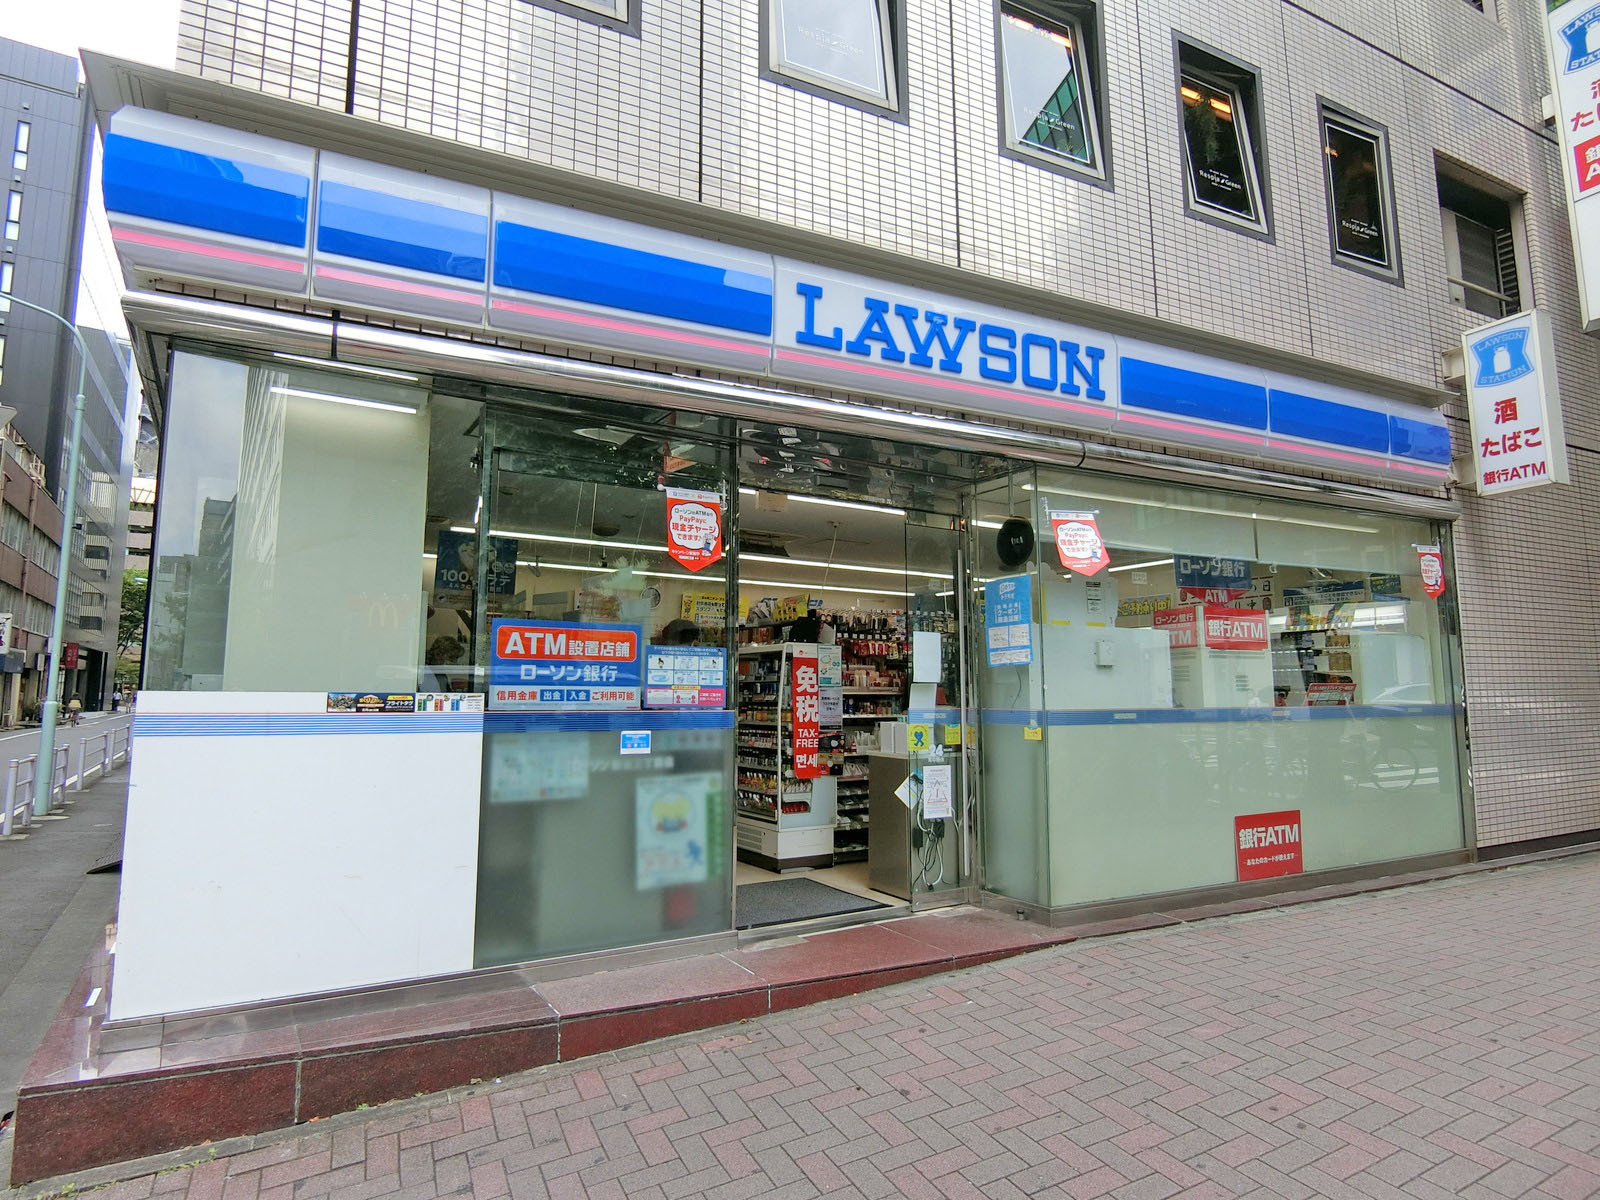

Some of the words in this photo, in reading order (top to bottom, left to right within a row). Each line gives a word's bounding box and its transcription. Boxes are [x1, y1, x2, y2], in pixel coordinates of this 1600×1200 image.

[796, 282, 1106, 400] LAWSON
[1477, 331, 1524, 351] LAWSON
[1480, 364, 1527, 384] STATION
[1494, 397, 1518, 425] 酒
[1481, 426, 1542, 457] たばこ
[1483, 461, 1546, 486] 銀行ATM
[672, 522, 717, 534] 現金チャージ
[1205, 589, 1228, 603] ATM
[1155, 613, 1193, 625] ローソン銀行
[1170, 630, 1192, 646] TM
[1208, 619, 1263, 639] 銀行ATM
[504, 632, 630, 658] ATM設置店舗
[520, 664, 618, 682] ローソン銀行
[496, 690, 538, 701] 信用金庫
[543, 691, 561, 700] 出金
[569, 691, 587, 700] 入金
[591, 691, 635, 701] ご利用可能
[796, 665, 819, 723] 免税
[798, 728, 818, 738] TAX-
[796, 738, 819, 748] FREE
[928, 744, 944, 757] 24
[796, 753, 818, 768] 면세
[1239, 823, 1299, 850] 銀行ATM
